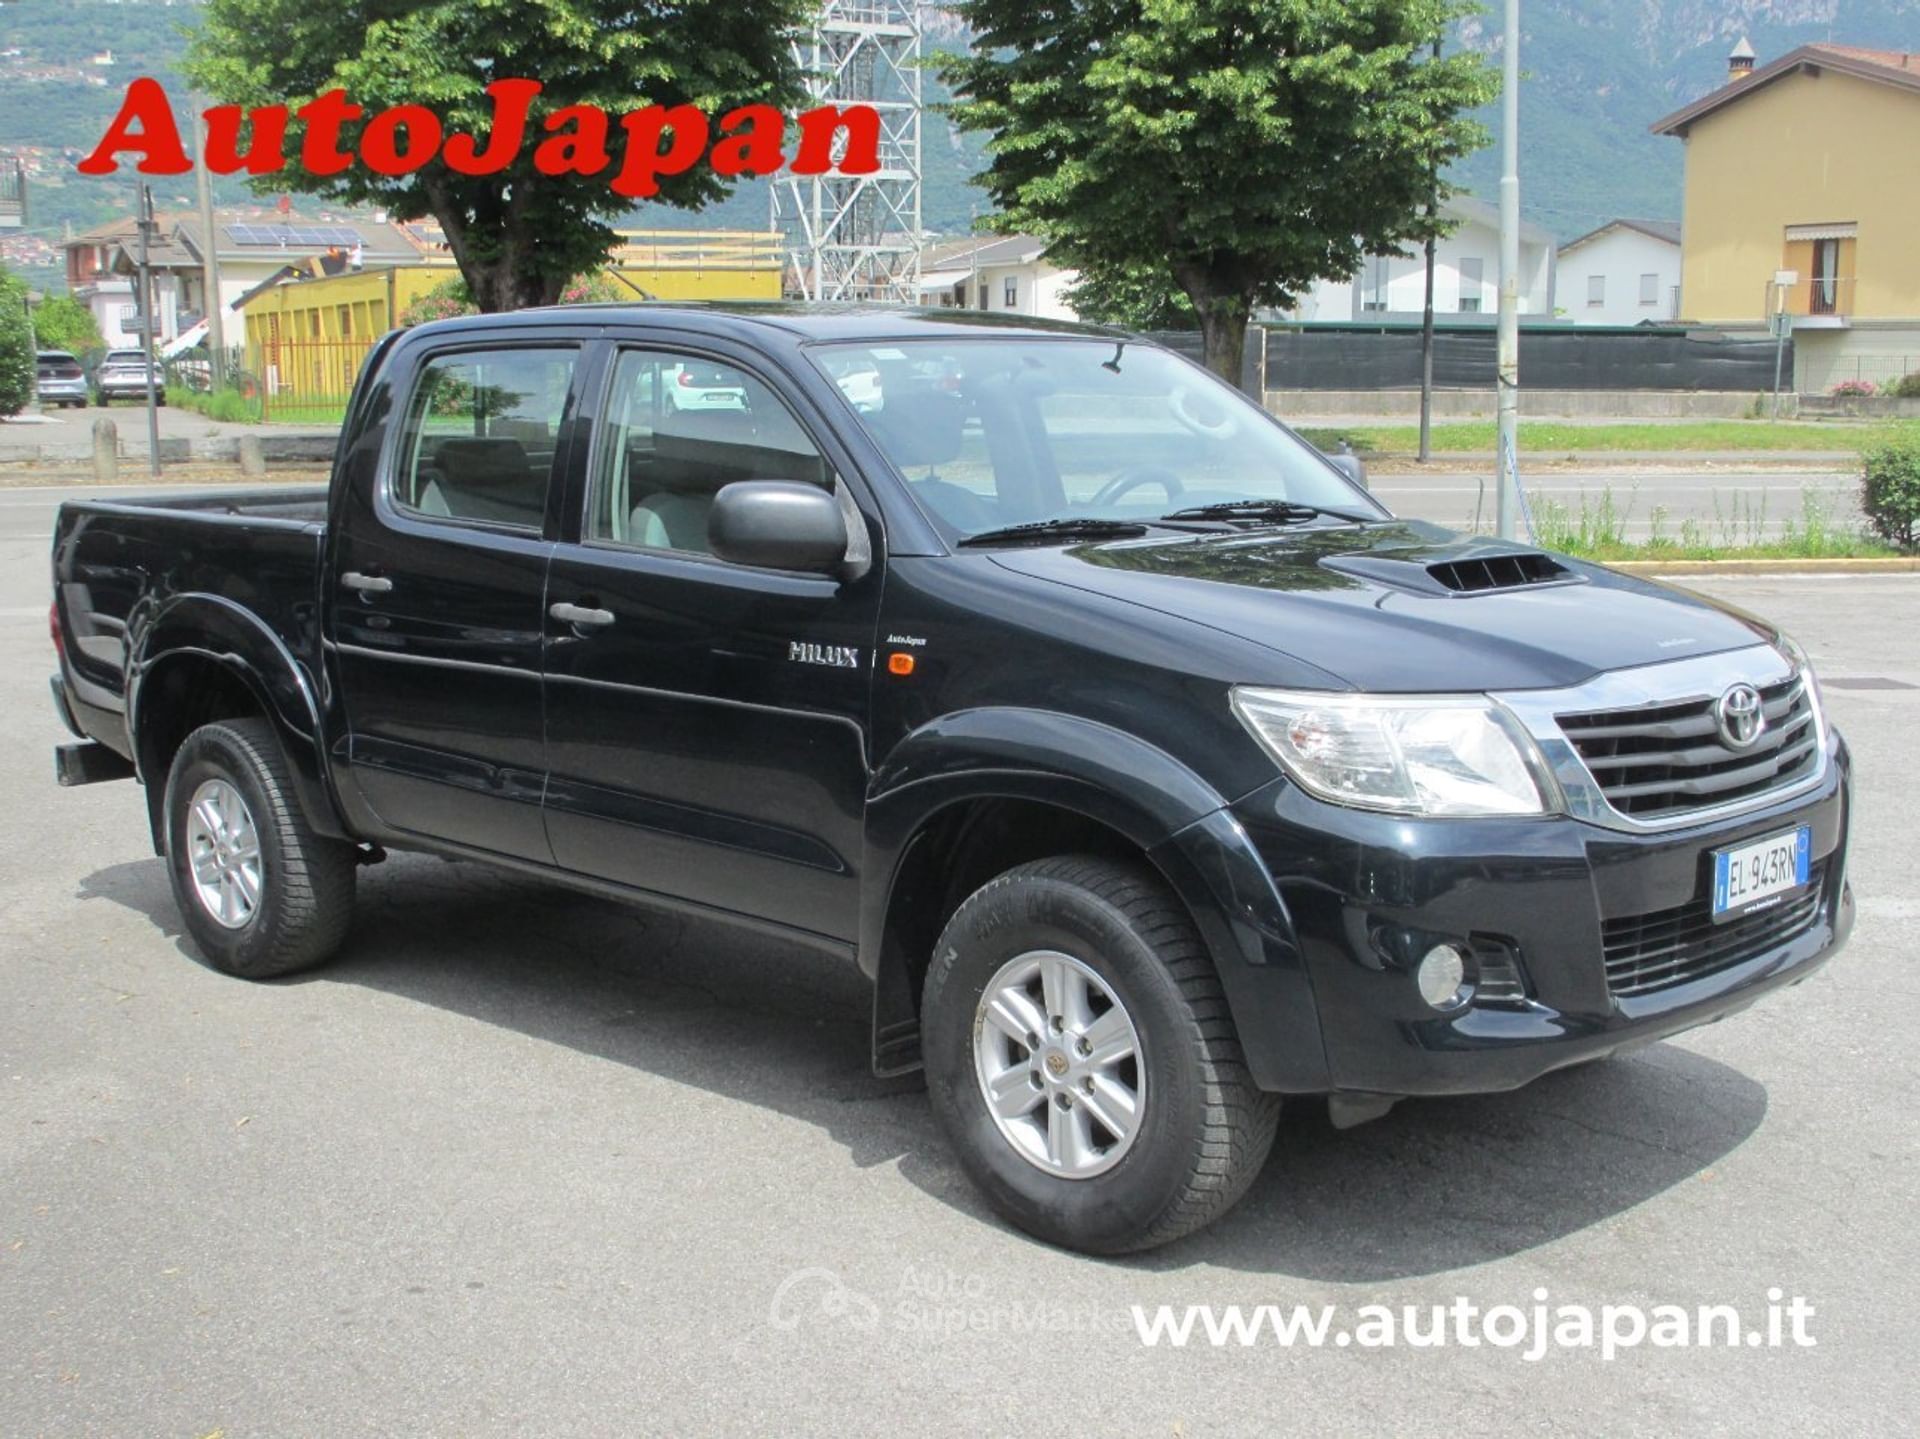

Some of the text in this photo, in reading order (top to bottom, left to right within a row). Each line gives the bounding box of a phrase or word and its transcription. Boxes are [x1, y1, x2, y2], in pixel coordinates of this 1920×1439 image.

[788, 641, 859, 669] HILUX
[1729, 842, 1797, 897] EL 943RN
